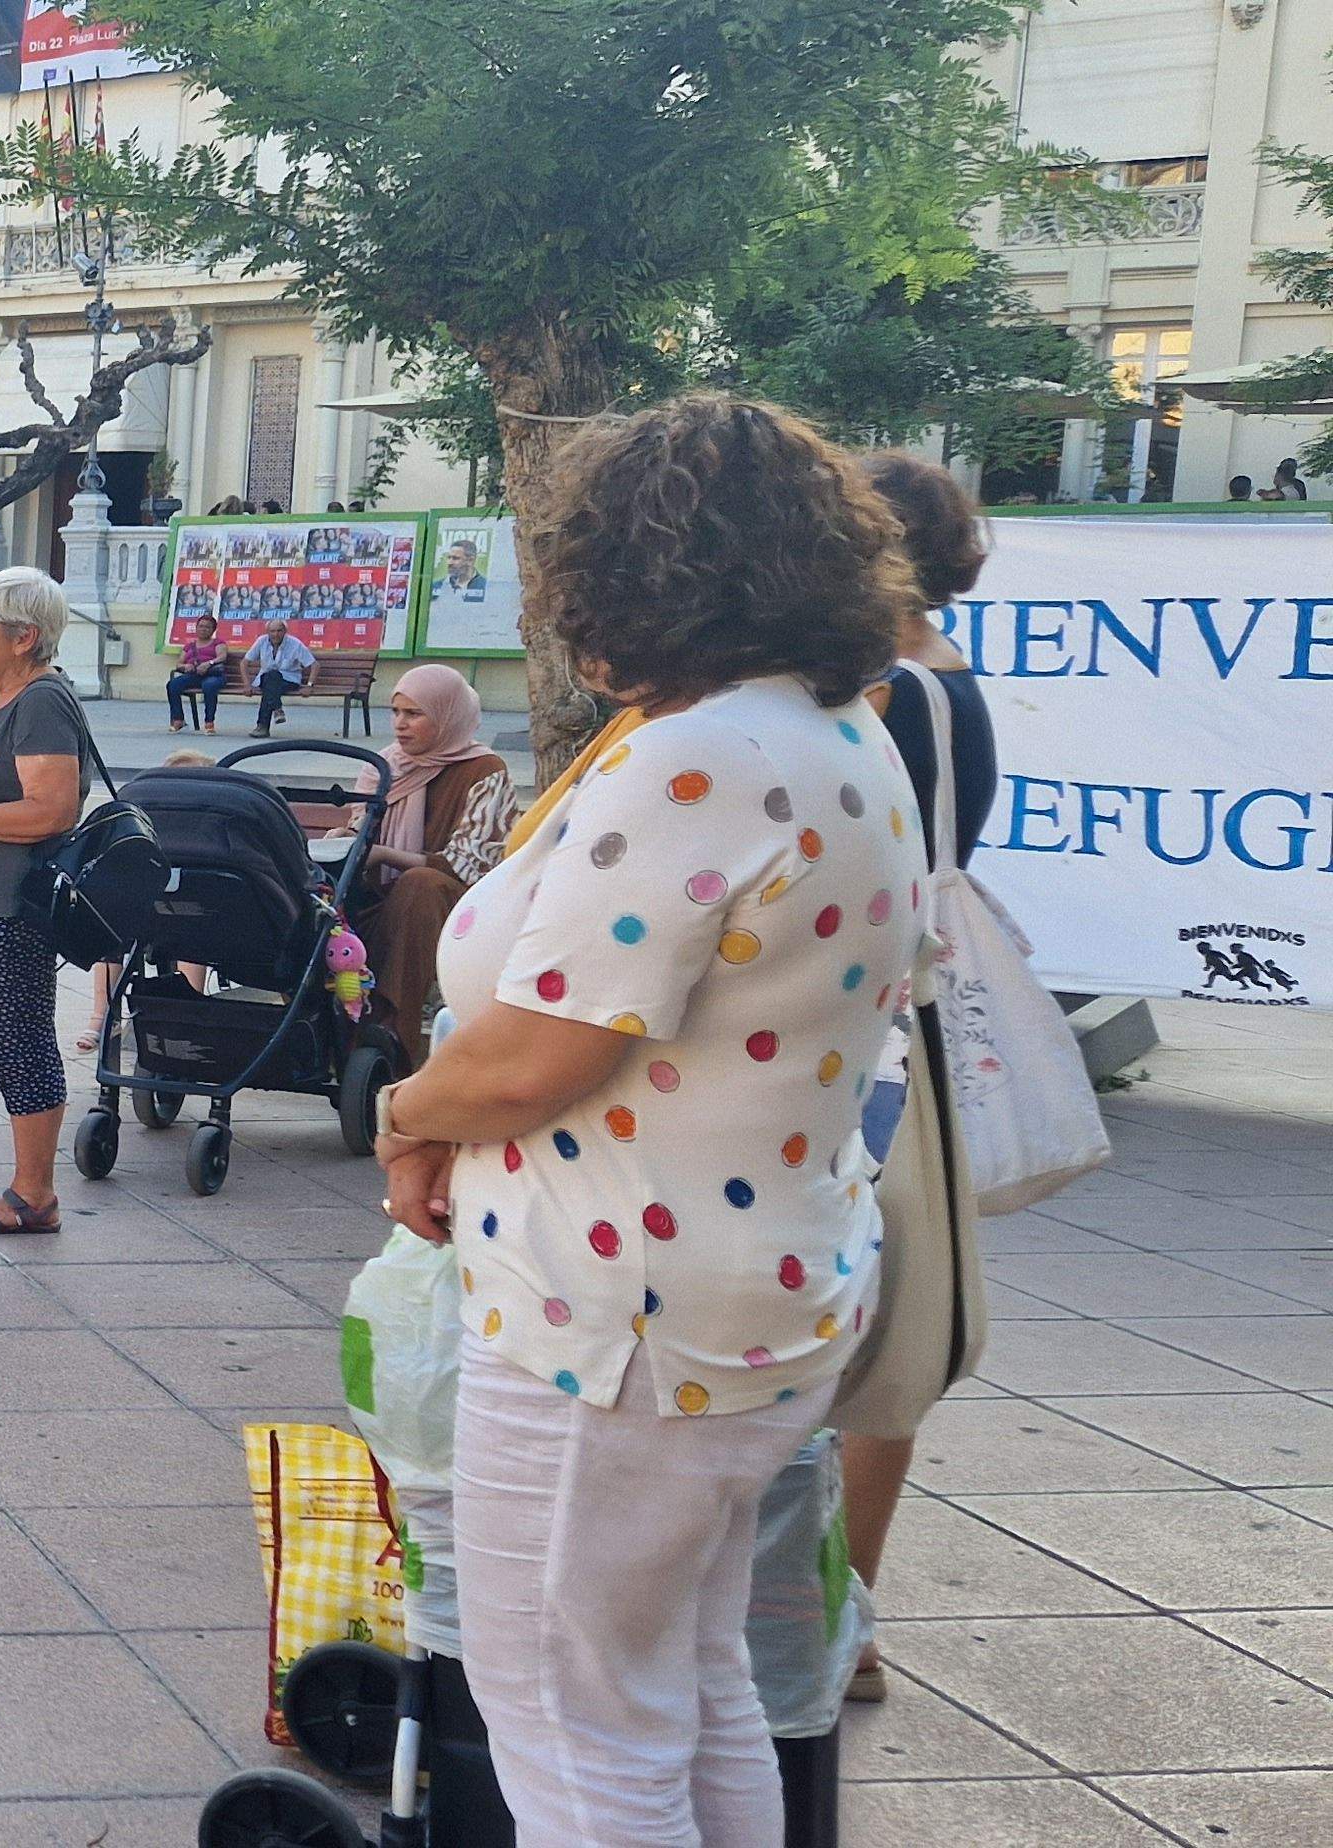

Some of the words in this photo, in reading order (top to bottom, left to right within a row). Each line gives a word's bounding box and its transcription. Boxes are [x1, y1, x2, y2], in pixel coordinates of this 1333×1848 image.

[49, 37, 63, 49] 22
[69, 33, 94, 46] Plaza
[974, 774, 1333, 873] EFUG
[1177, 922, 1306, 947] BIENVENIDXS
